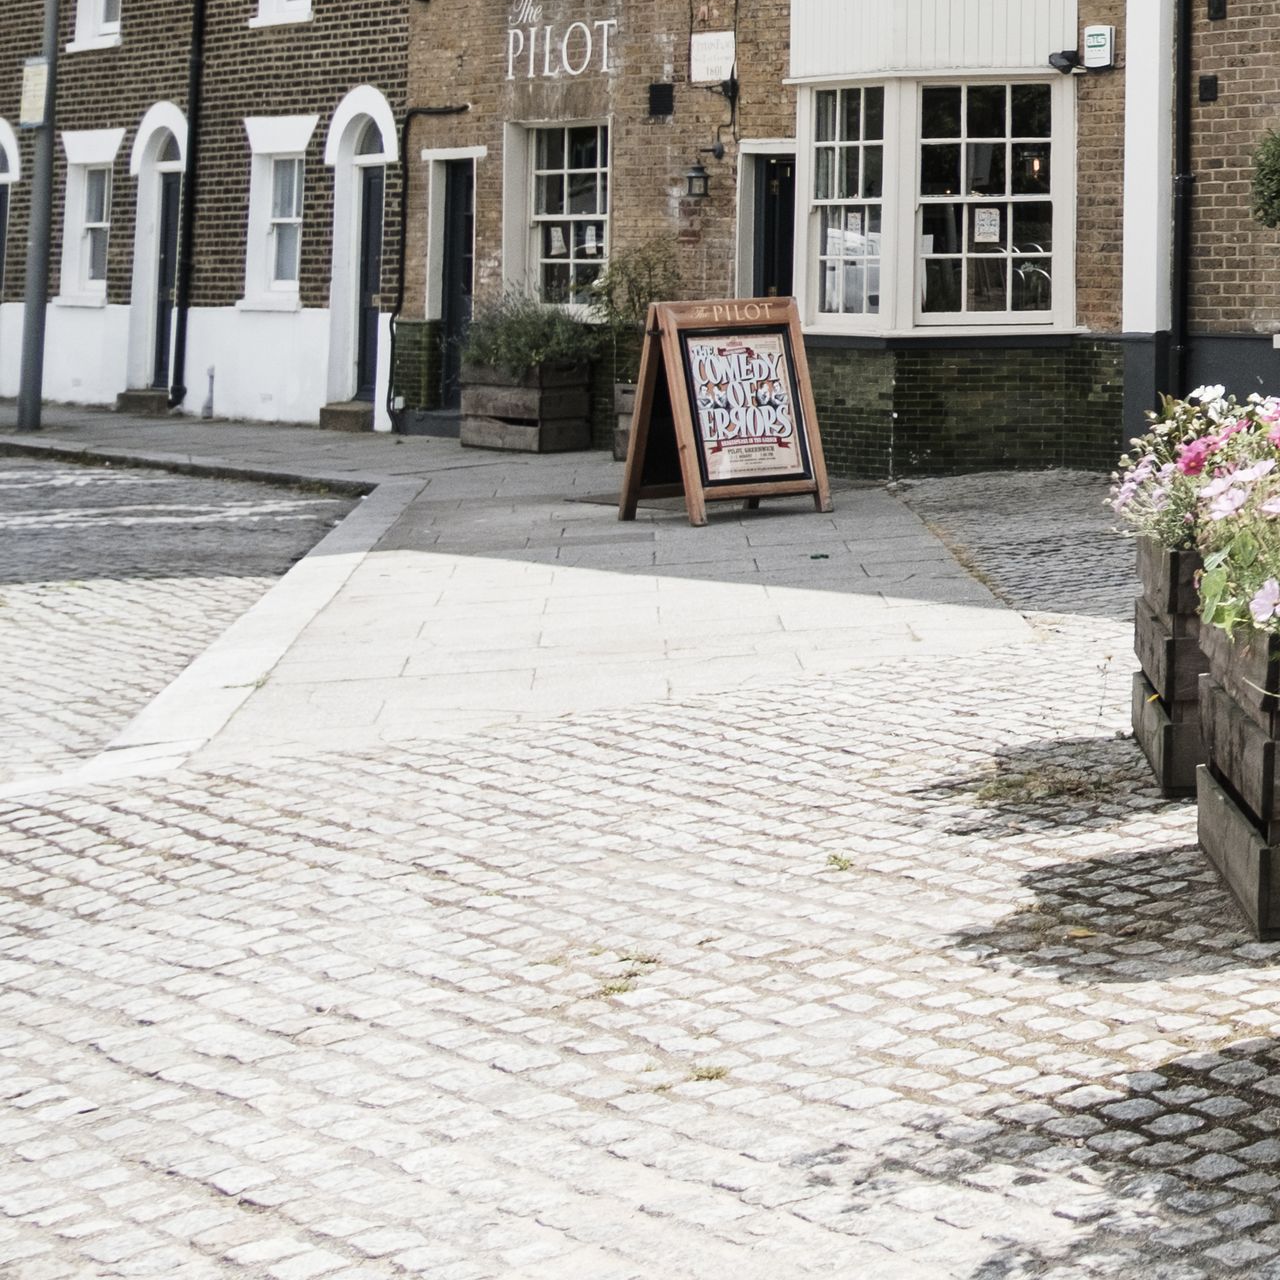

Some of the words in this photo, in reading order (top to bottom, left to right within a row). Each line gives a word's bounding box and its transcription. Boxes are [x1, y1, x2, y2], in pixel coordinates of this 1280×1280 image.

[505, 19, 618, 80] PILOT
[712, 302, 773, 322] PILOT
[691, 352, 783, 387] COMEDY
[726, 381, 758, 408] OF
[698, 405, 794, 440] ERRORS
